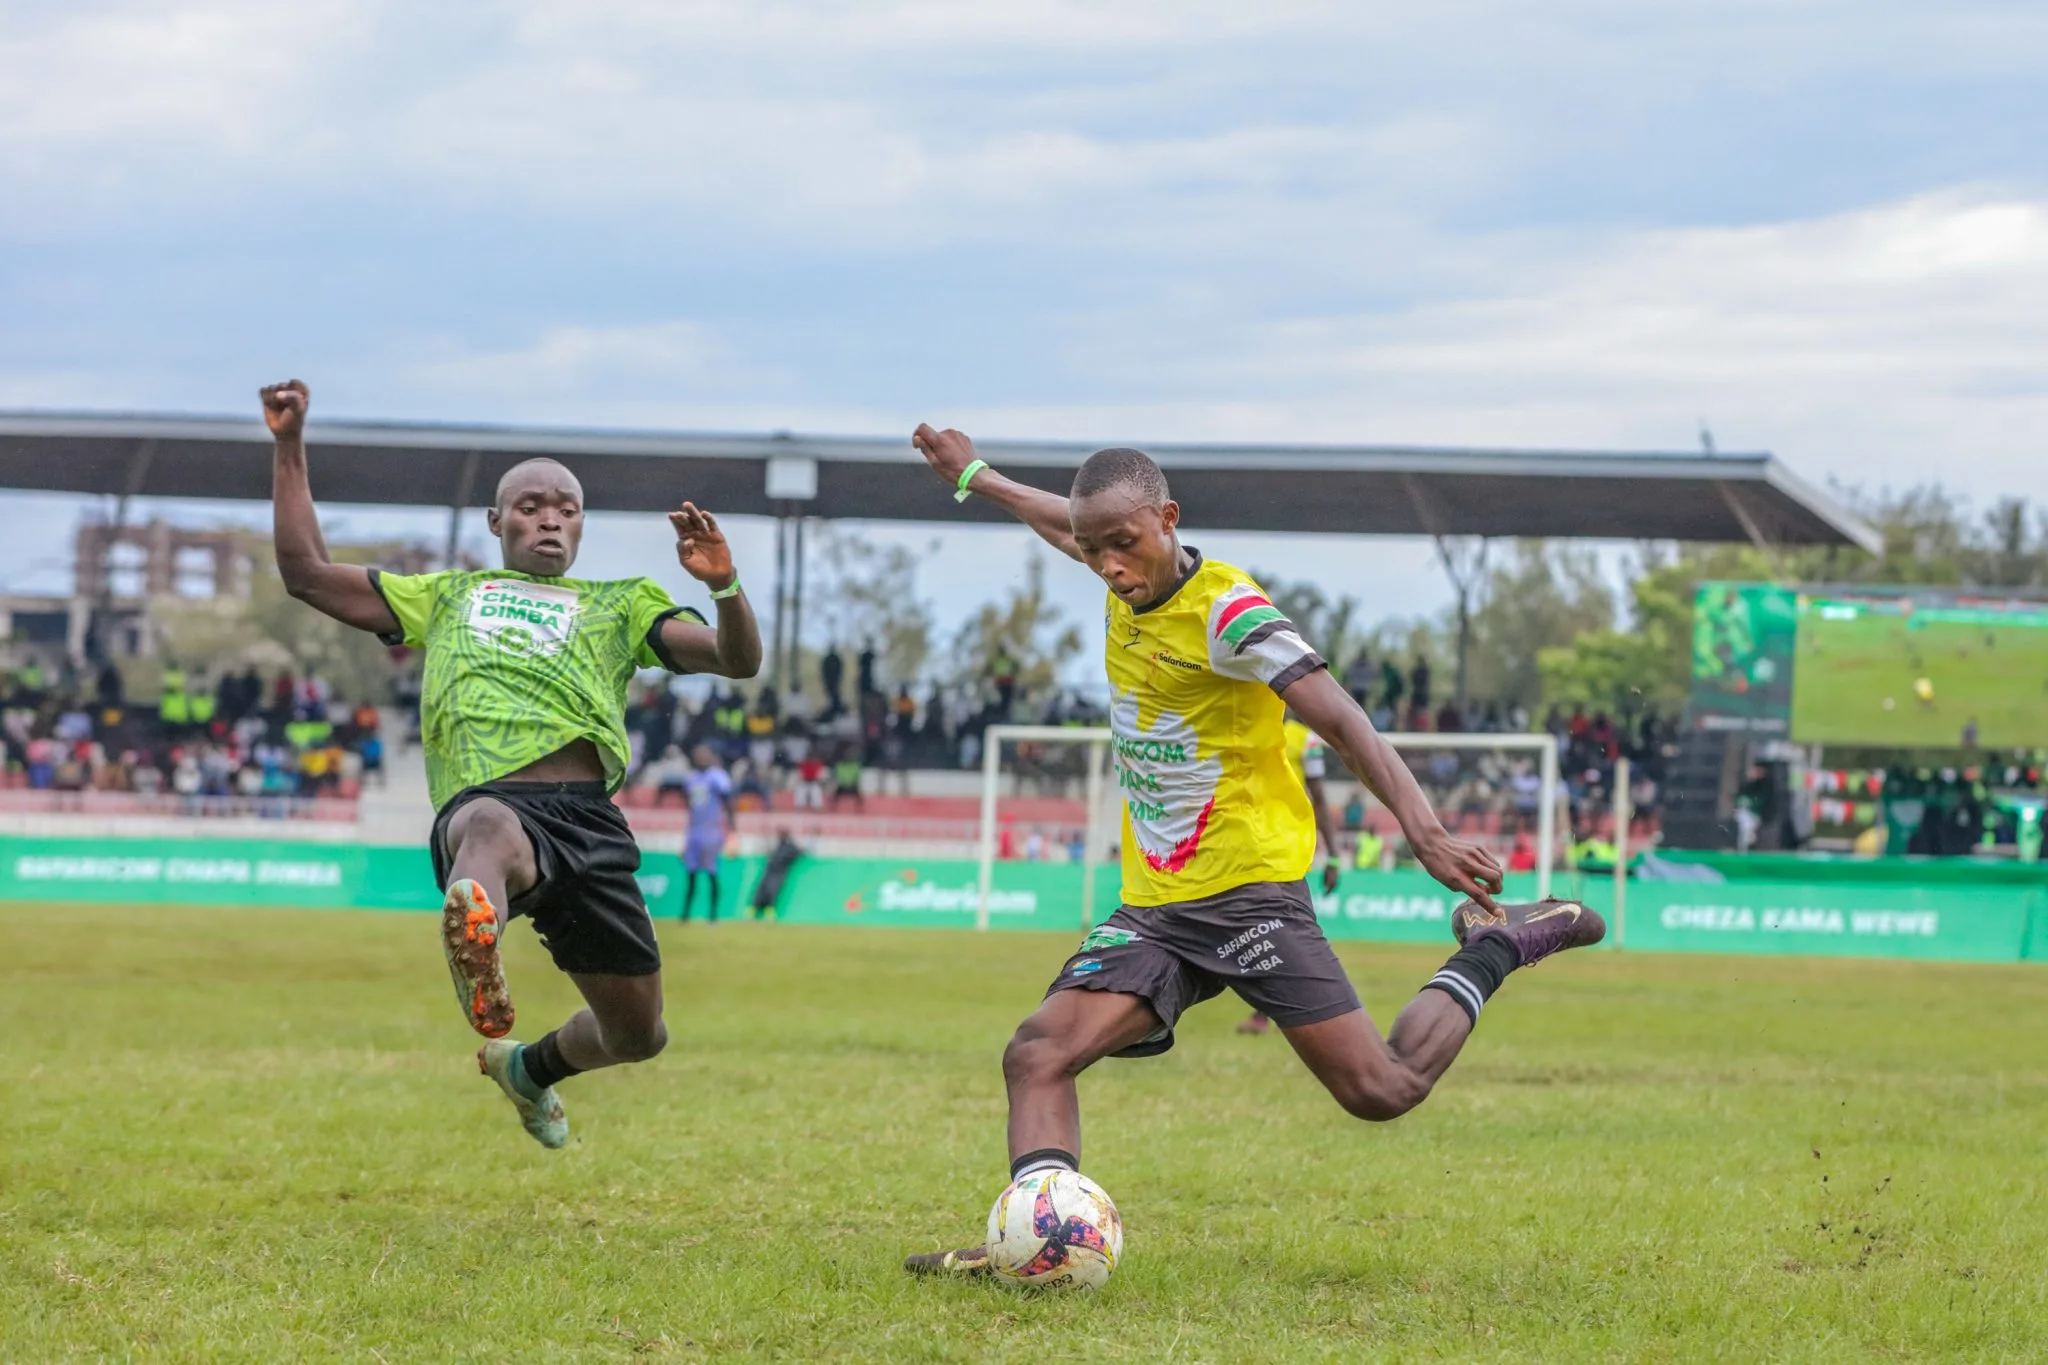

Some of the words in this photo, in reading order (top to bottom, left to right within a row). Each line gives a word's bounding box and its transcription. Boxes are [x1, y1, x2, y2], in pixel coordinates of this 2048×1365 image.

[482, 592, 565, 613] CHAPA
[480, 605, 558, 629] DIMBA
[1159, 653, 1202, 671] Safaricom
[166, 858, 250, 883] CHAPA
[879, 881, 1037, 914] Safaricom
[1345, 896, 1444, 920] CHAPA
[1660, 904, 1755, 931] CHEZA
[1761, 907, 1844, 933] KAMA
[1851, 909, 1939, 936] WEWE
[1217, 918, 1284, 959] SAFARICOM
[1238, 940, 1275, 967] CHAPA
